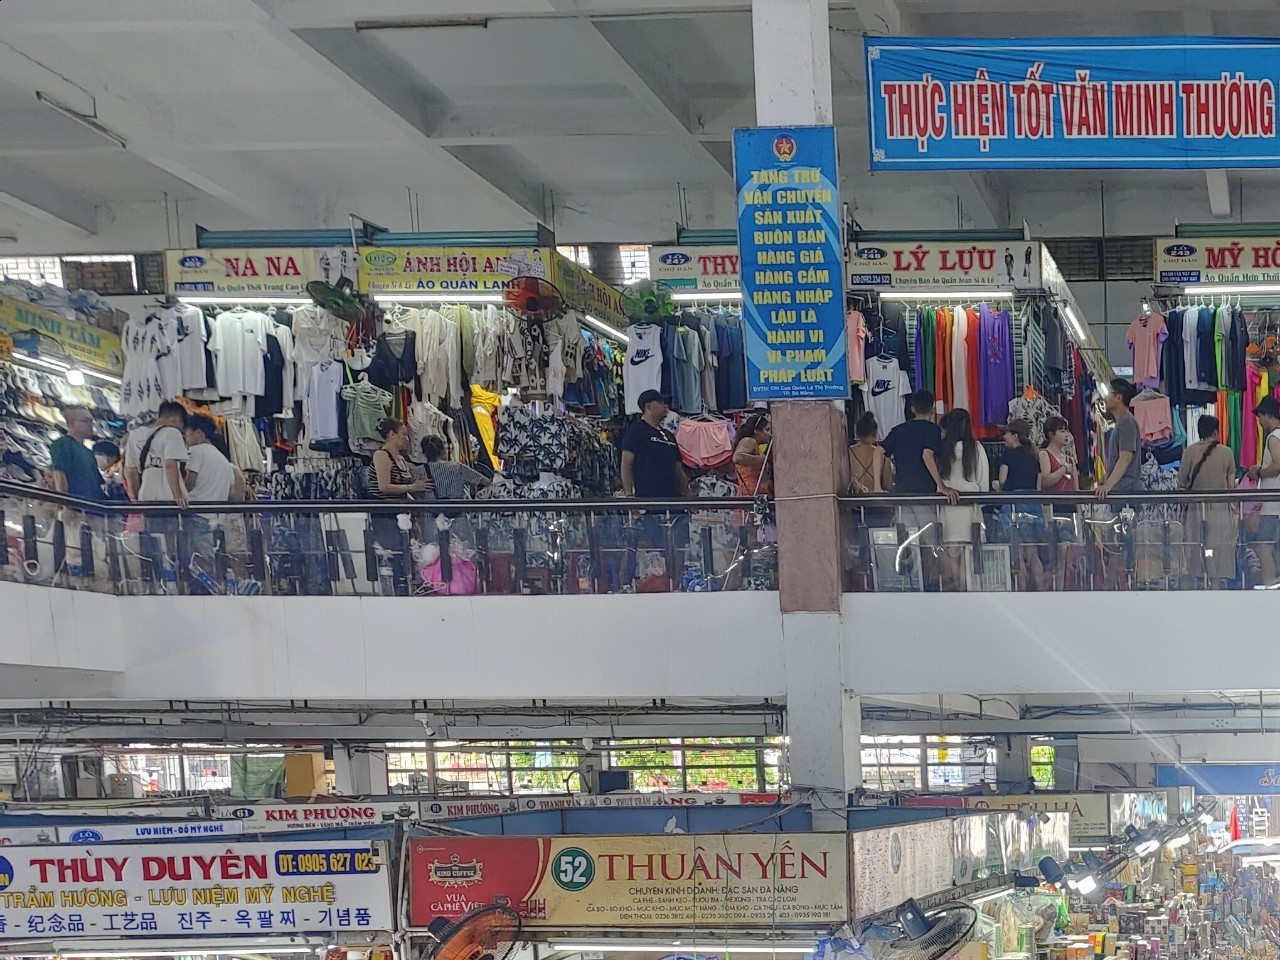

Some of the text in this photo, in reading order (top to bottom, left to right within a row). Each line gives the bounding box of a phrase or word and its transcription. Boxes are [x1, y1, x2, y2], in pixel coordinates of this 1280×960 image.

[880, 73, 946, 153] THỰC
[950, 68, 1008, 152] HIỆN
[1009, 62, 1057, 139] TỐT
[1057, 70, 1109, 139] VĂN
[1113, 80, 1176, 139] MINH
[1179, 71, 1276, 139] THƯƠNG
[744, 185, 832, 207] VẬN CHUYỂN
[754, 206, 822, 225] SẢN XUẤT
[753, 228, 826, 245] BUÔN BÁN
[757, 247, 824, 265] HÀNG GIẢ
[893, 245, 996, 275] LÝ LỰU
[1205, 242, 1245, 270] MỸ
[224, 257, 259, 277] NA
[266, 256, 301, 276] NA
[755, 266, 829, 284] HÀNG CẤM
[1218, 272, 1240, 282] Quần
[753, 288, 833, 305] HÀNG NHẬP
[771, 308, 817, 326] LẬU LÀ
[767, 329, 824, 344] HÀNH VI
[635, 348, 651, 357] NIKE
[767, 349, 826, 364] VI PHẠM
[760, 368, 833, 384] PHÁP LUẬT
[874, 378, 892, 390] NIKE
[236, 806, 376, 821] 61 KIM PHƯƠNG
[447, 802, 499, 817] KIM PHƯƠNG
[29, 850, 129, 884] THÙY
[142, 849, 268, 880] DUYÊN
[278, 854, 296, 873] ĐT:
[297, 853, 328, 873] 0905
[330, 852, 352, 872] 627
[559, 857, 587, 883] 52
[599, 840, 830, 887] THUẬN YẾN
[2, 883, 337, 910] TRẦM HƯƠNG LƯU NIỆM MỸ NGHỆ
[445, 894, 466, 902] VUA
[628, 886, 664, 895] CHUYÊN
[665, 886, 685, 895] KINH
[686, 886, 720, 895] DOANH:
[430, 901, 461, 911] CÀ PHÊ
[27, 912, 85, 933] 纪念品
[103, 911, 158, 931] 工艺品
[177, 908, 372, 930] 진주 기념품
